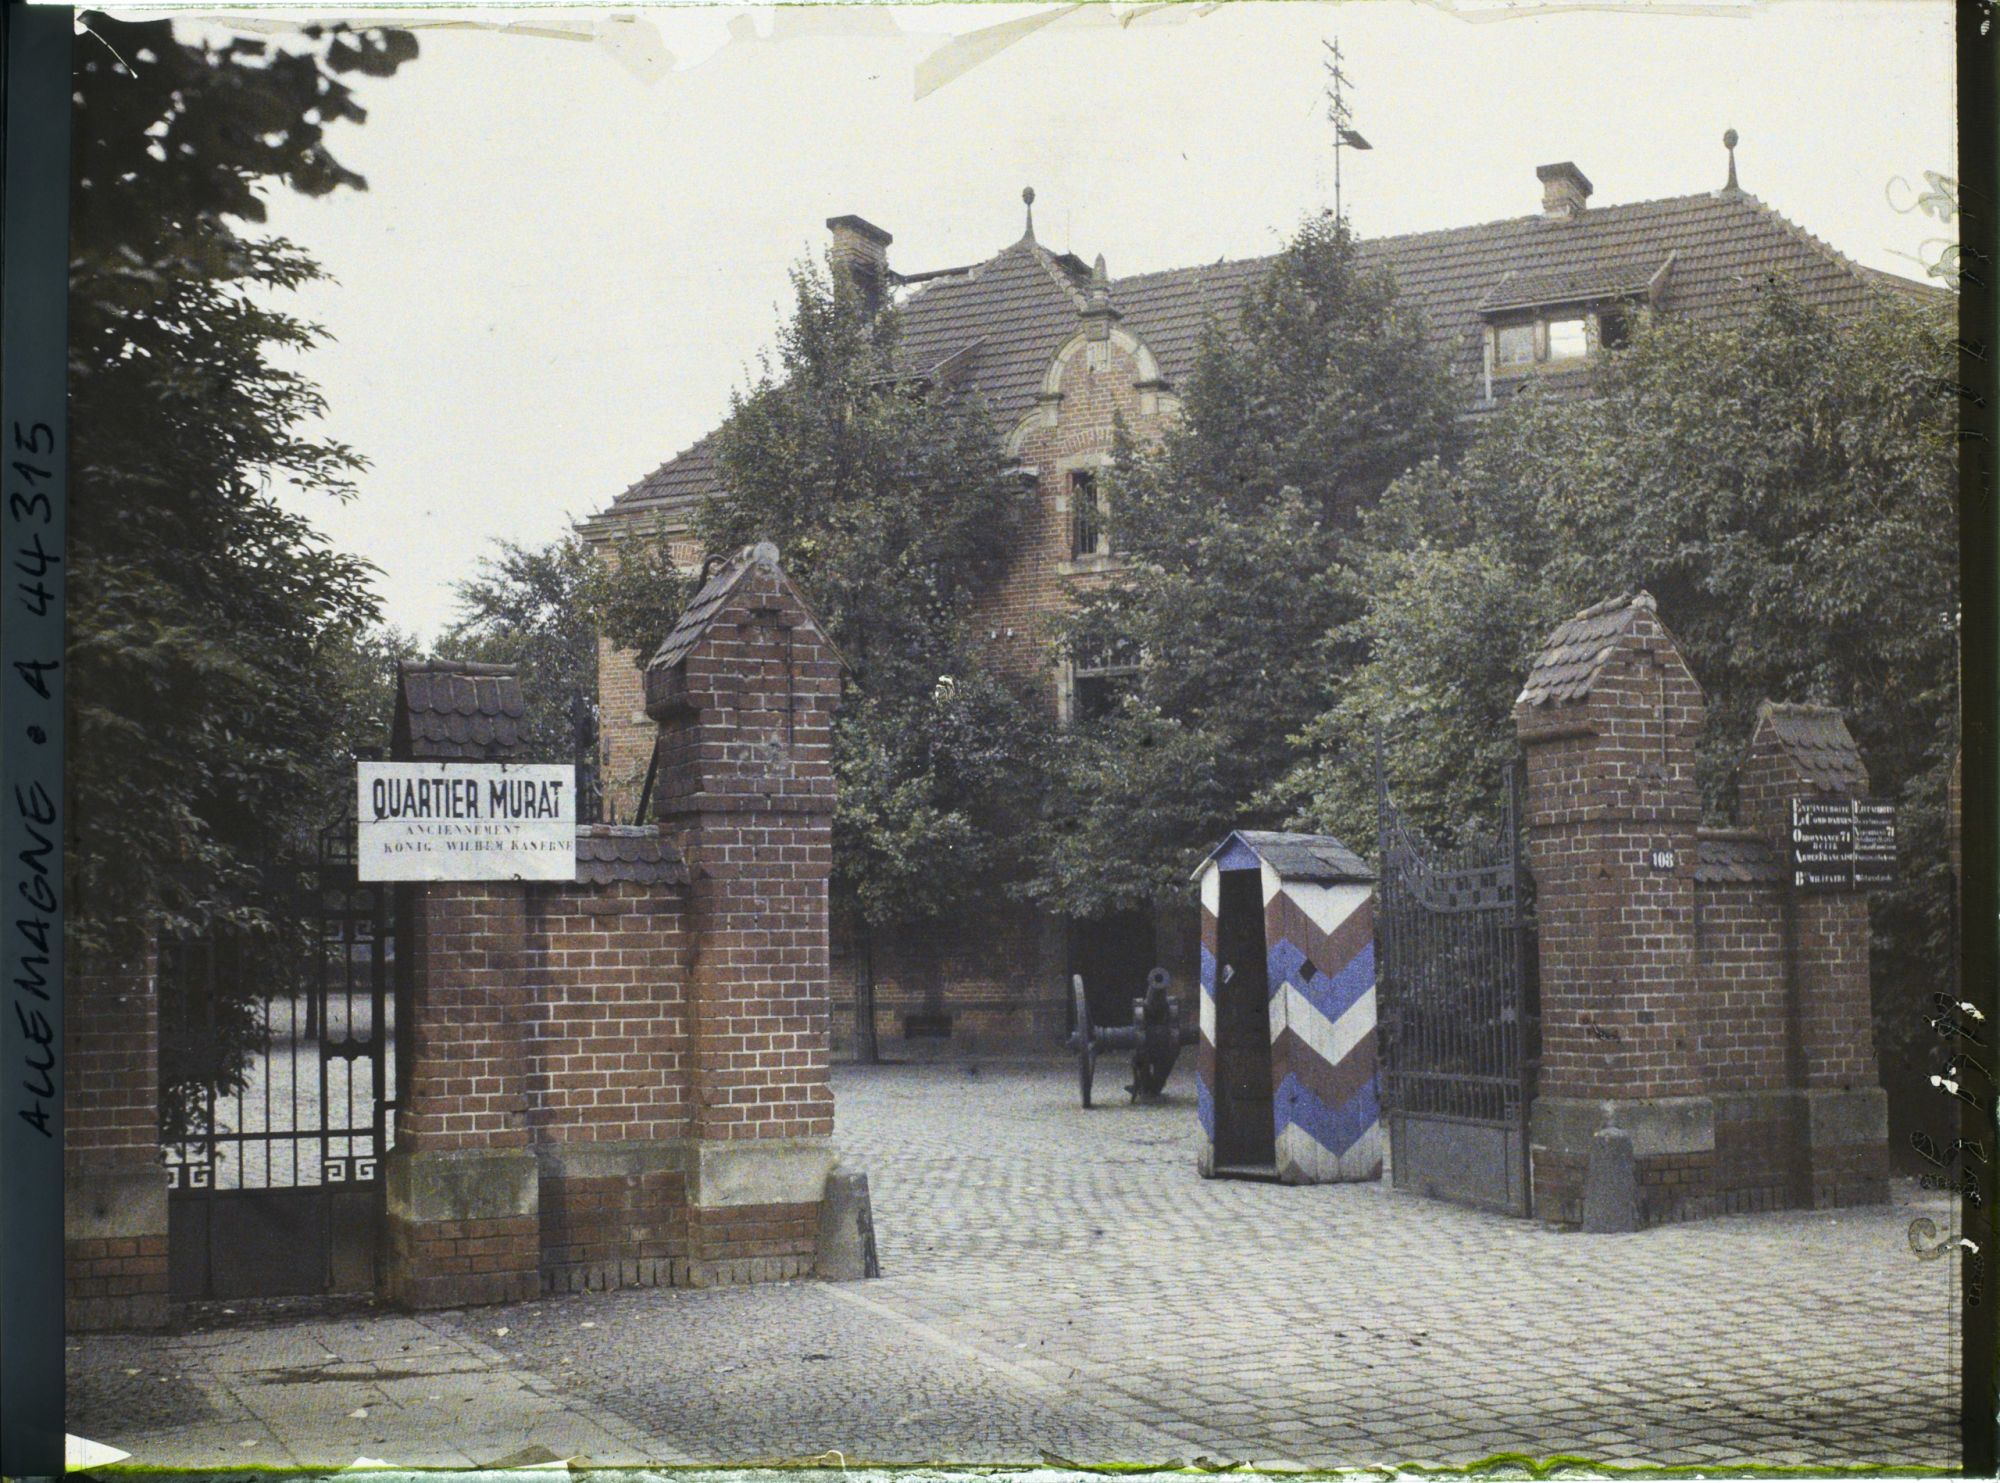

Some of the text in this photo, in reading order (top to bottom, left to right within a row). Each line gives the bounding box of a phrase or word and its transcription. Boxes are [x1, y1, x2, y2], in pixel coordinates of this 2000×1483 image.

[10, 420, 61, 617] 44315
[373, 777, 564, 824] QUARTIER MURAT
[406, 824, 521, 835] ANCIENNEMENT
[1652, 852, 1674, 868] 108
[14, 779, 57, 1138] ALLEMAGNE
